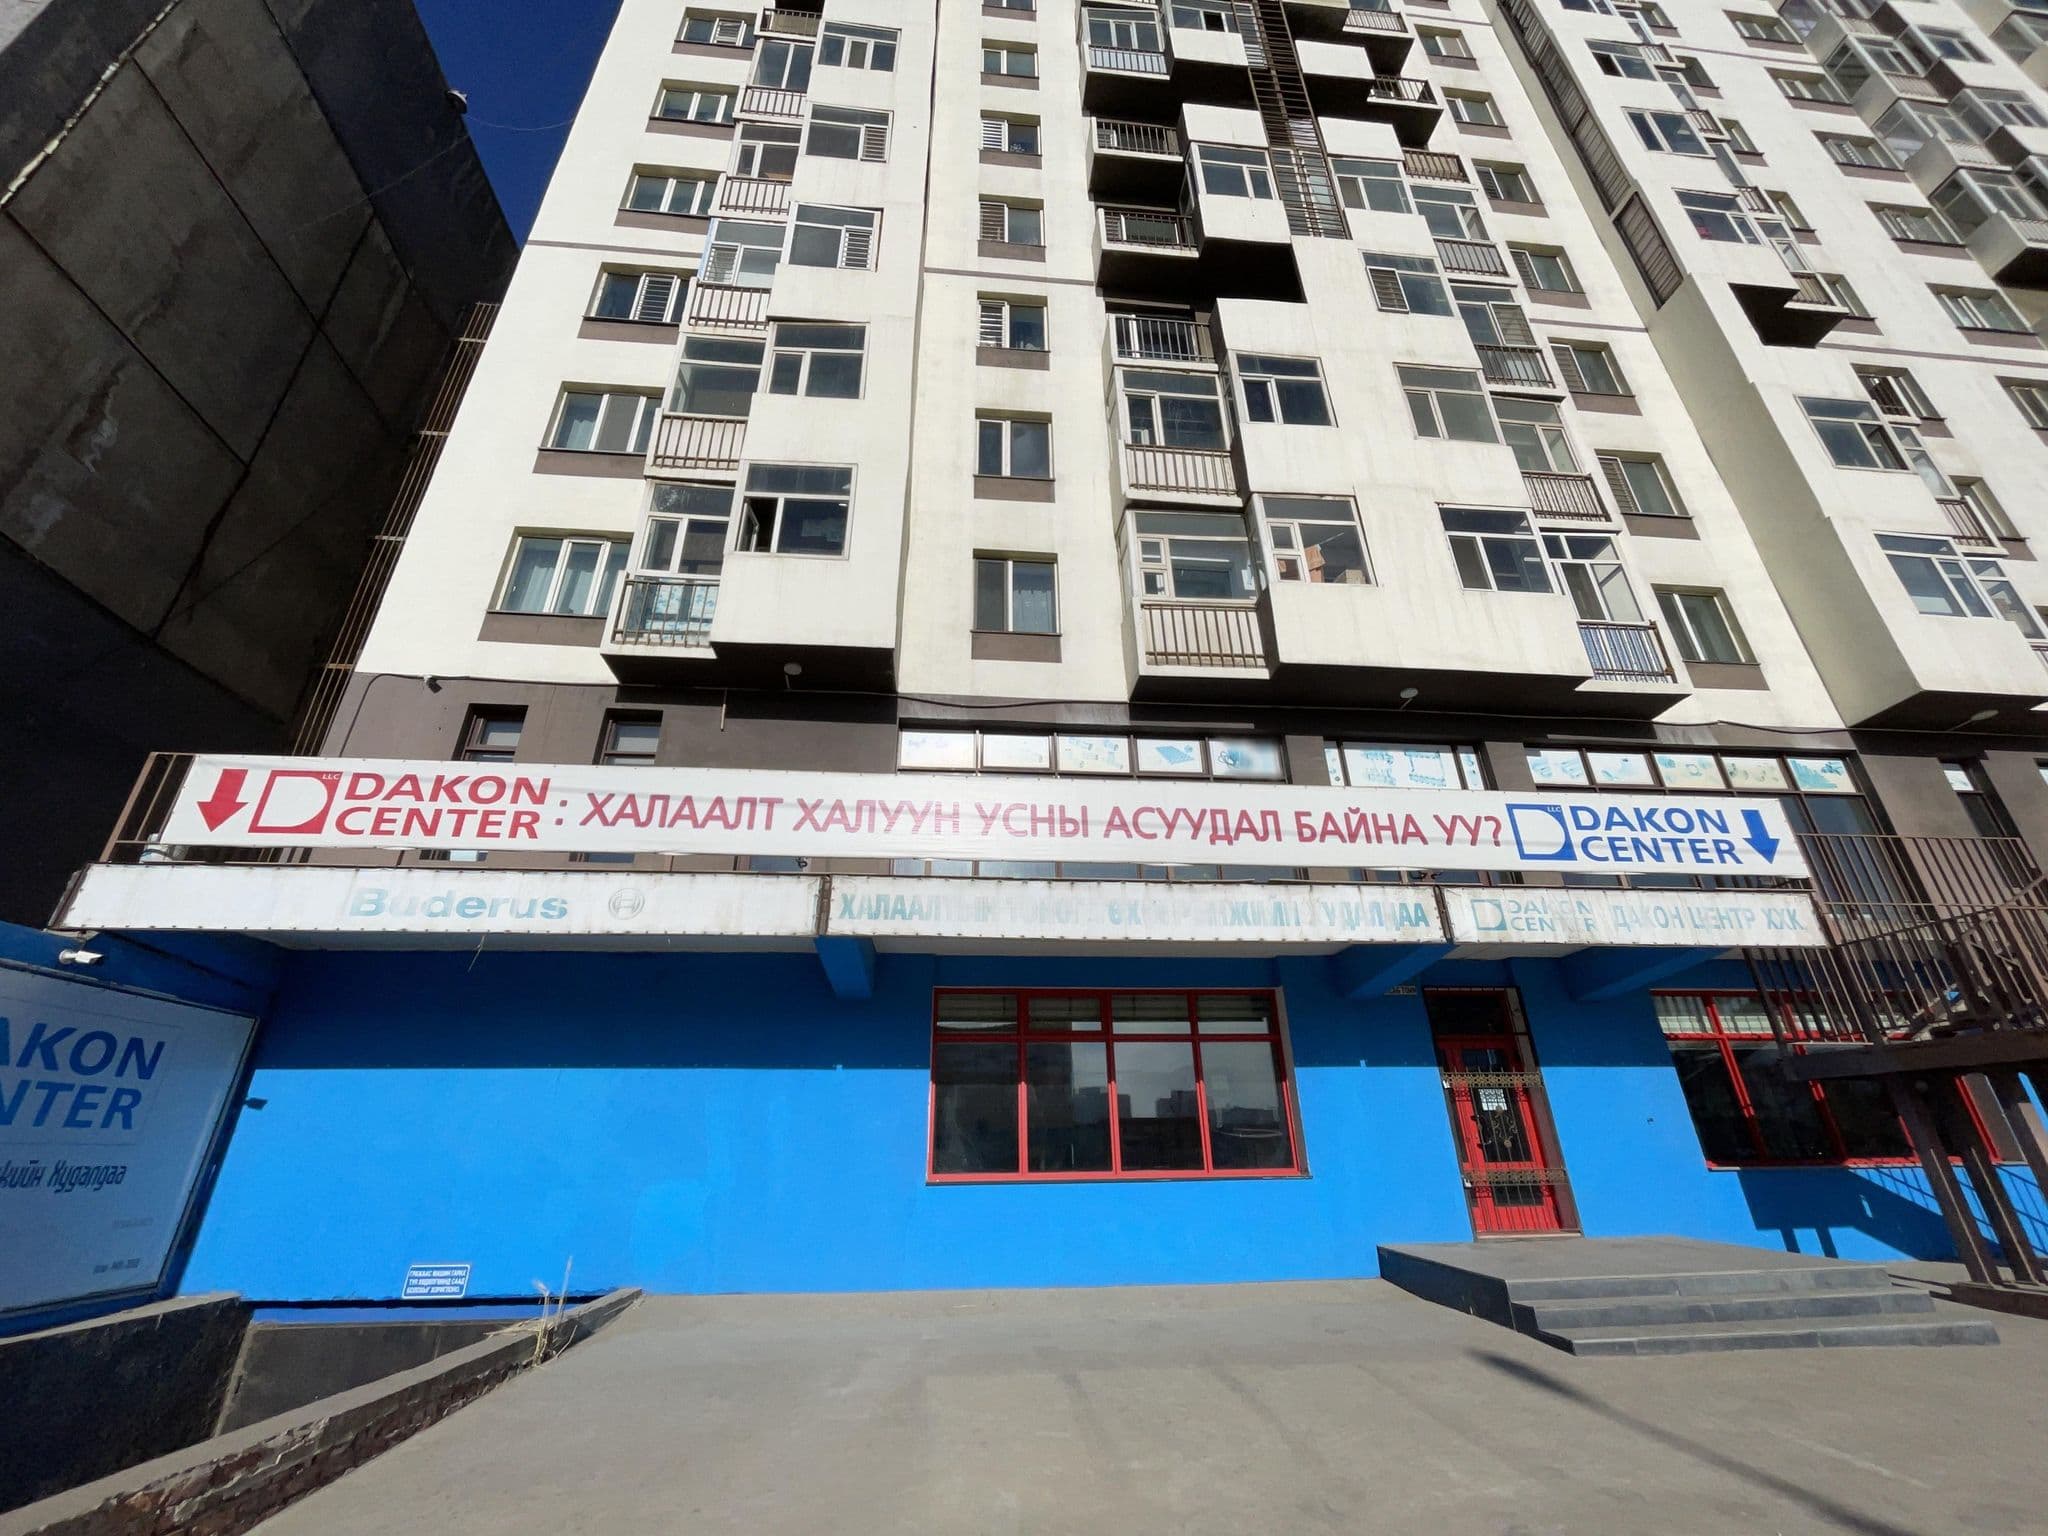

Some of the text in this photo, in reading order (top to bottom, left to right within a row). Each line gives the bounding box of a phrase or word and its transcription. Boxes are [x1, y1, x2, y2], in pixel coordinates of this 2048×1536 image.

[344, 772, 551, 805] DAKON
[335, 806, 540, 839] CENTER
[579, 792, 784, 831] ХАЛААЛТ
[792, 798, 961, 835] ХАЛУУН
[974, 801, 1089, 838] УСНЫ
[1103, 806, 1282, 846] АСУУДАЛ
[1294, 806, 1429, 846] БАЙНА
[1432, 814, 1502, 847] УУ?
[1569, 805, 1731, 834] DAKON
[1580, 836, 1743, 865] CENTER
[349, 887, 569, 920] Buderus
[0, 1016, 166, 1080] KON
